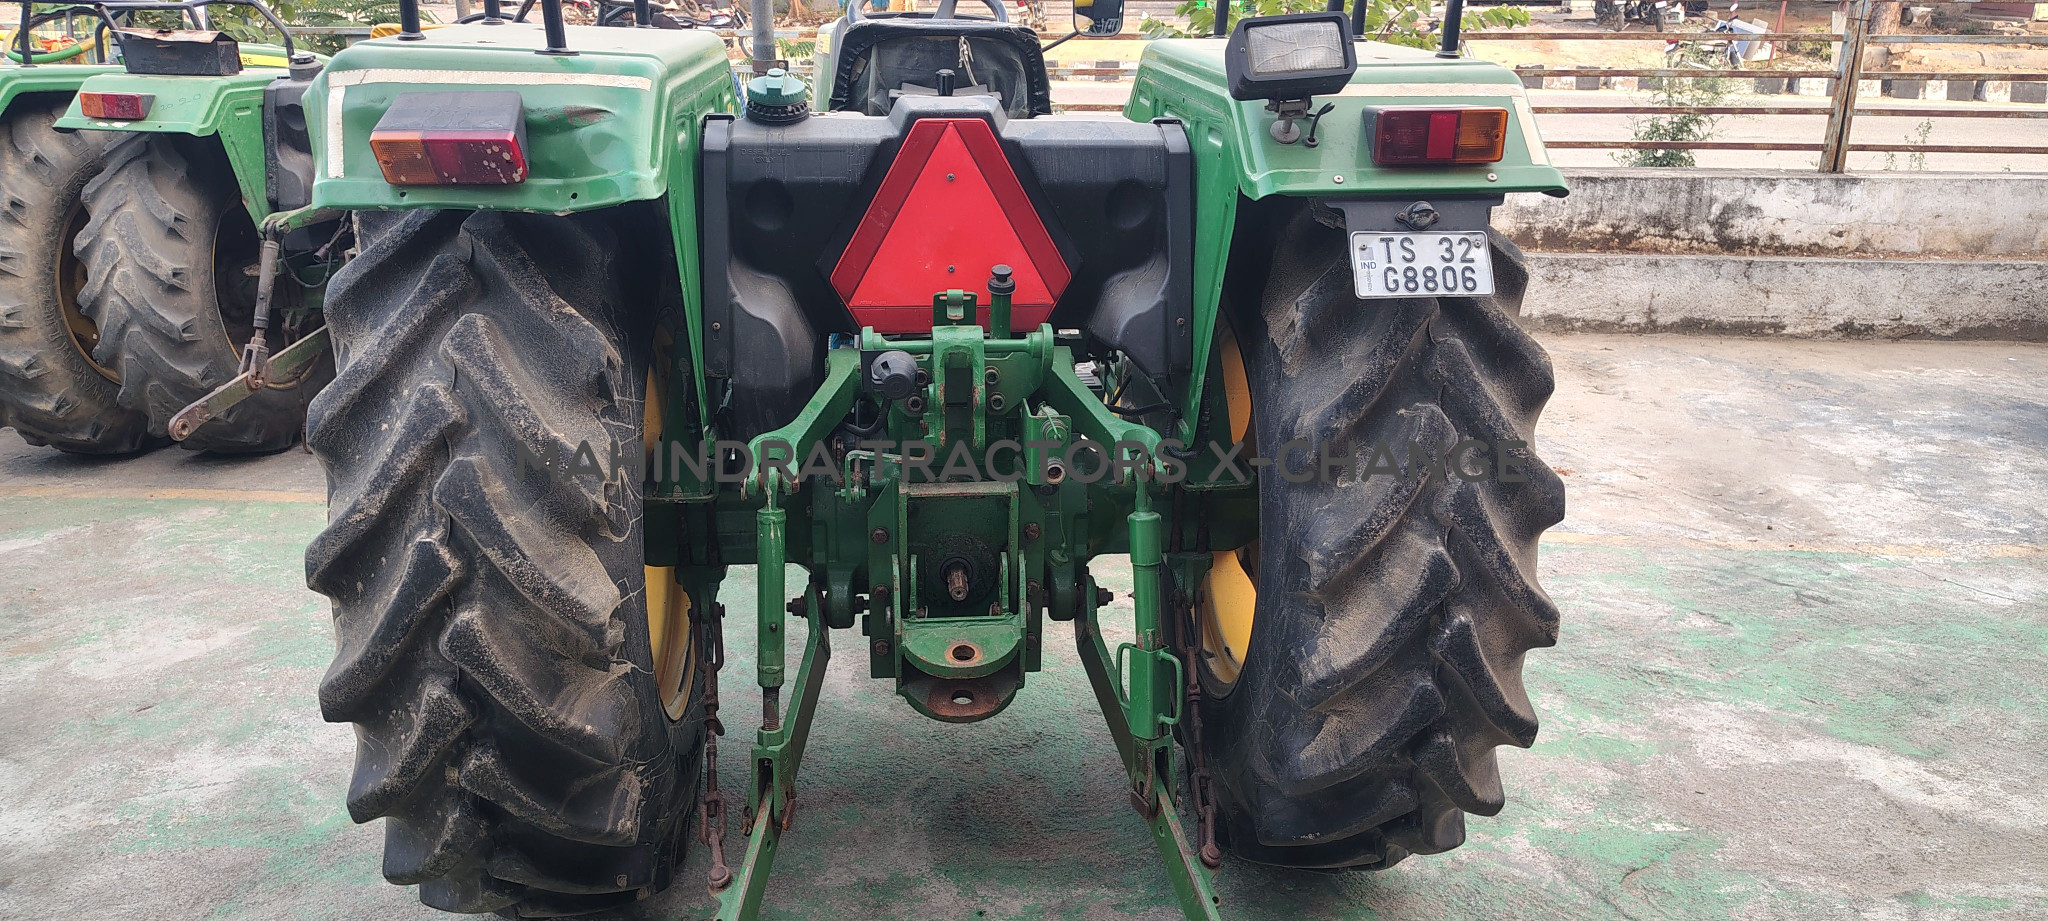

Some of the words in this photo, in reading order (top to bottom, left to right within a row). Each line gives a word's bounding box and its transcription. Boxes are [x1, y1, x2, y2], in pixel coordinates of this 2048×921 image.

[1379, 237, 1416, 264] TS
[1438, 236, 1475, 263] 32
[1360, 261, 1377, 270] IND
[1383, 265, 1477, 292] G8806
